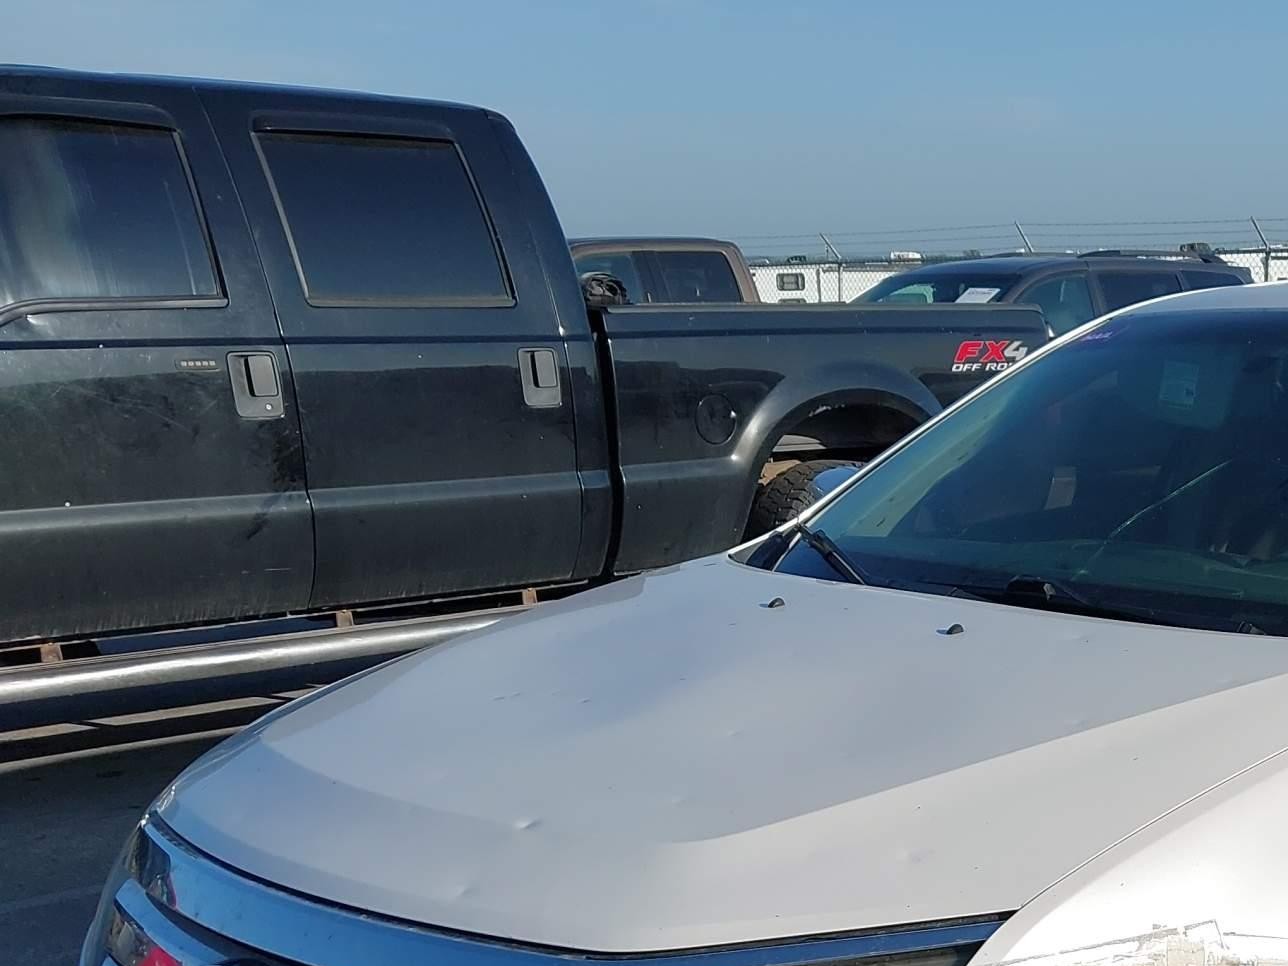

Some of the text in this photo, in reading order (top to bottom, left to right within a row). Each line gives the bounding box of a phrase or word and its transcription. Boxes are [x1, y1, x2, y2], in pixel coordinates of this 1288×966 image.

[954, 340, 1027, 362] FX4
[951, 362, 1012, 373] OFF RO
